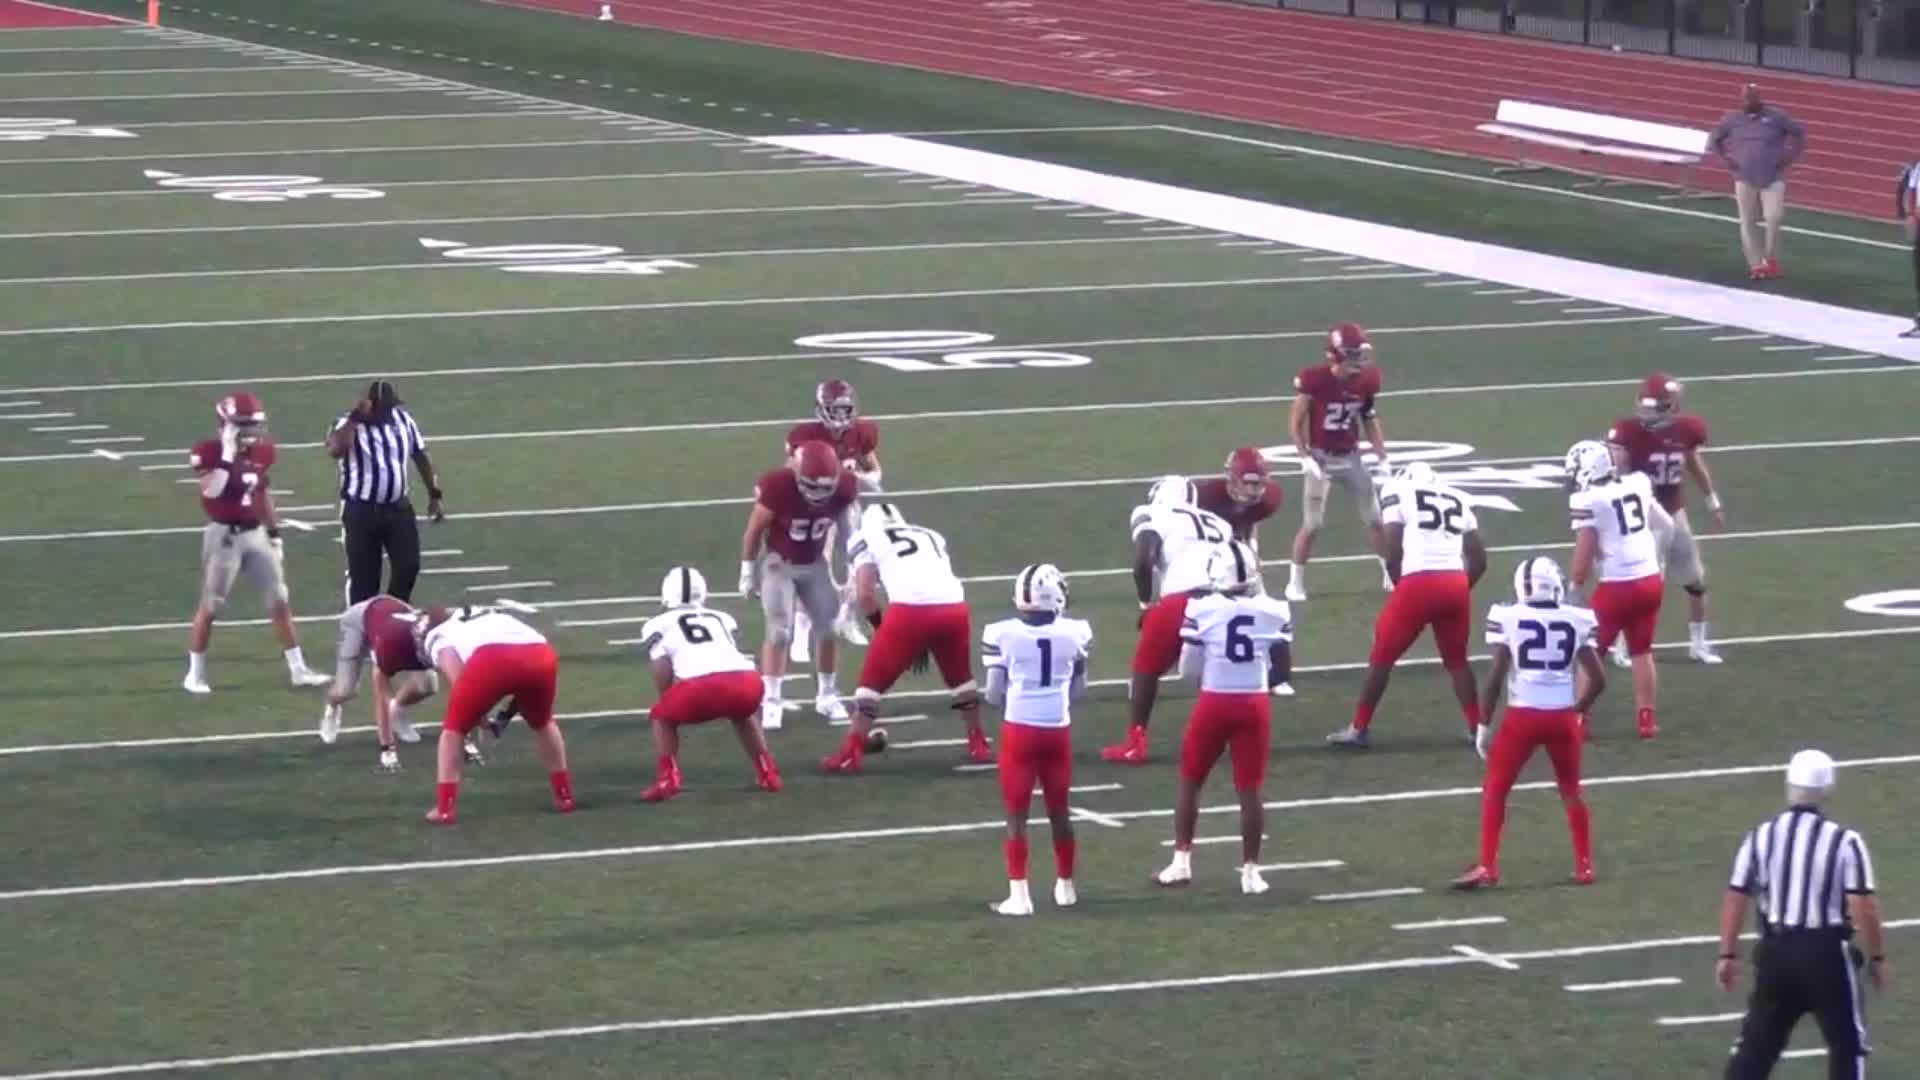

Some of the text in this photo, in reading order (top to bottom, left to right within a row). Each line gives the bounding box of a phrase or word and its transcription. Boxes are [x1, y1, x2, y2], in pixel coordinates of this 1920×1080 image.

[793, 330, 1092, 371] 50
[241, 472, 259, 506] 7
[1415, 489, 1463, 535] 52
[1611, 493, 1645, 536] 13
[1225, 615, 1256, 663] 6
[1517, 619, 1576, 670] 23
[1036, 637, 1052, 688] 1
